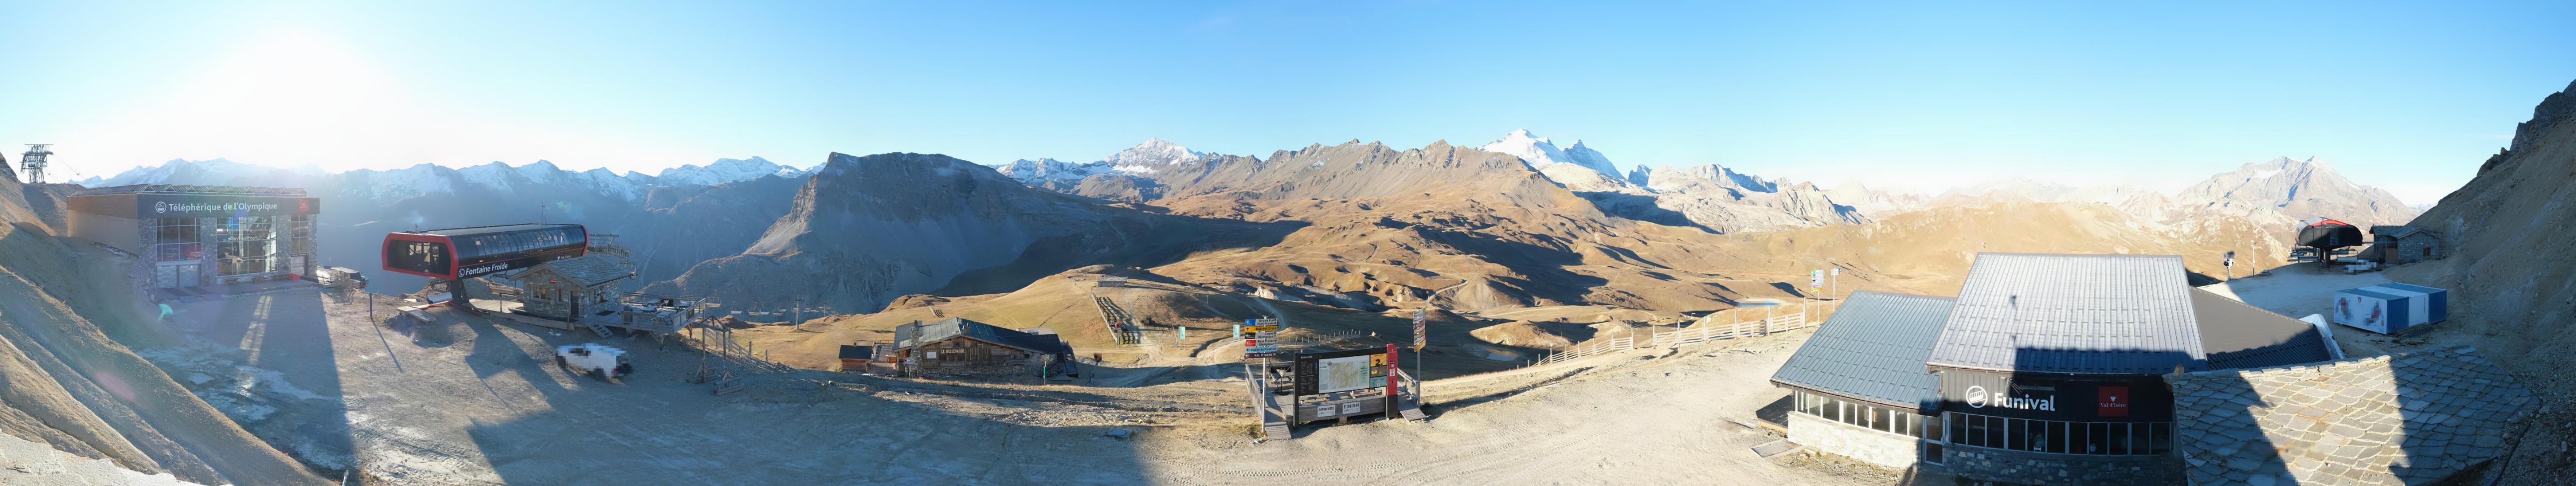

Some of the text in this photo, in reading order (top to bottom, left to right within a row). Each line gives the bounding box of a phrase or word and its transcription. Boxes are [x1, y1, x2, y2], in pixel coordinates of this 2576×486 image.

[168, 203, 221, 213] Téléphérique
[466, 262, 508, 275] Fontaine Froide
[1994, 392, 2055, 411] Funival
